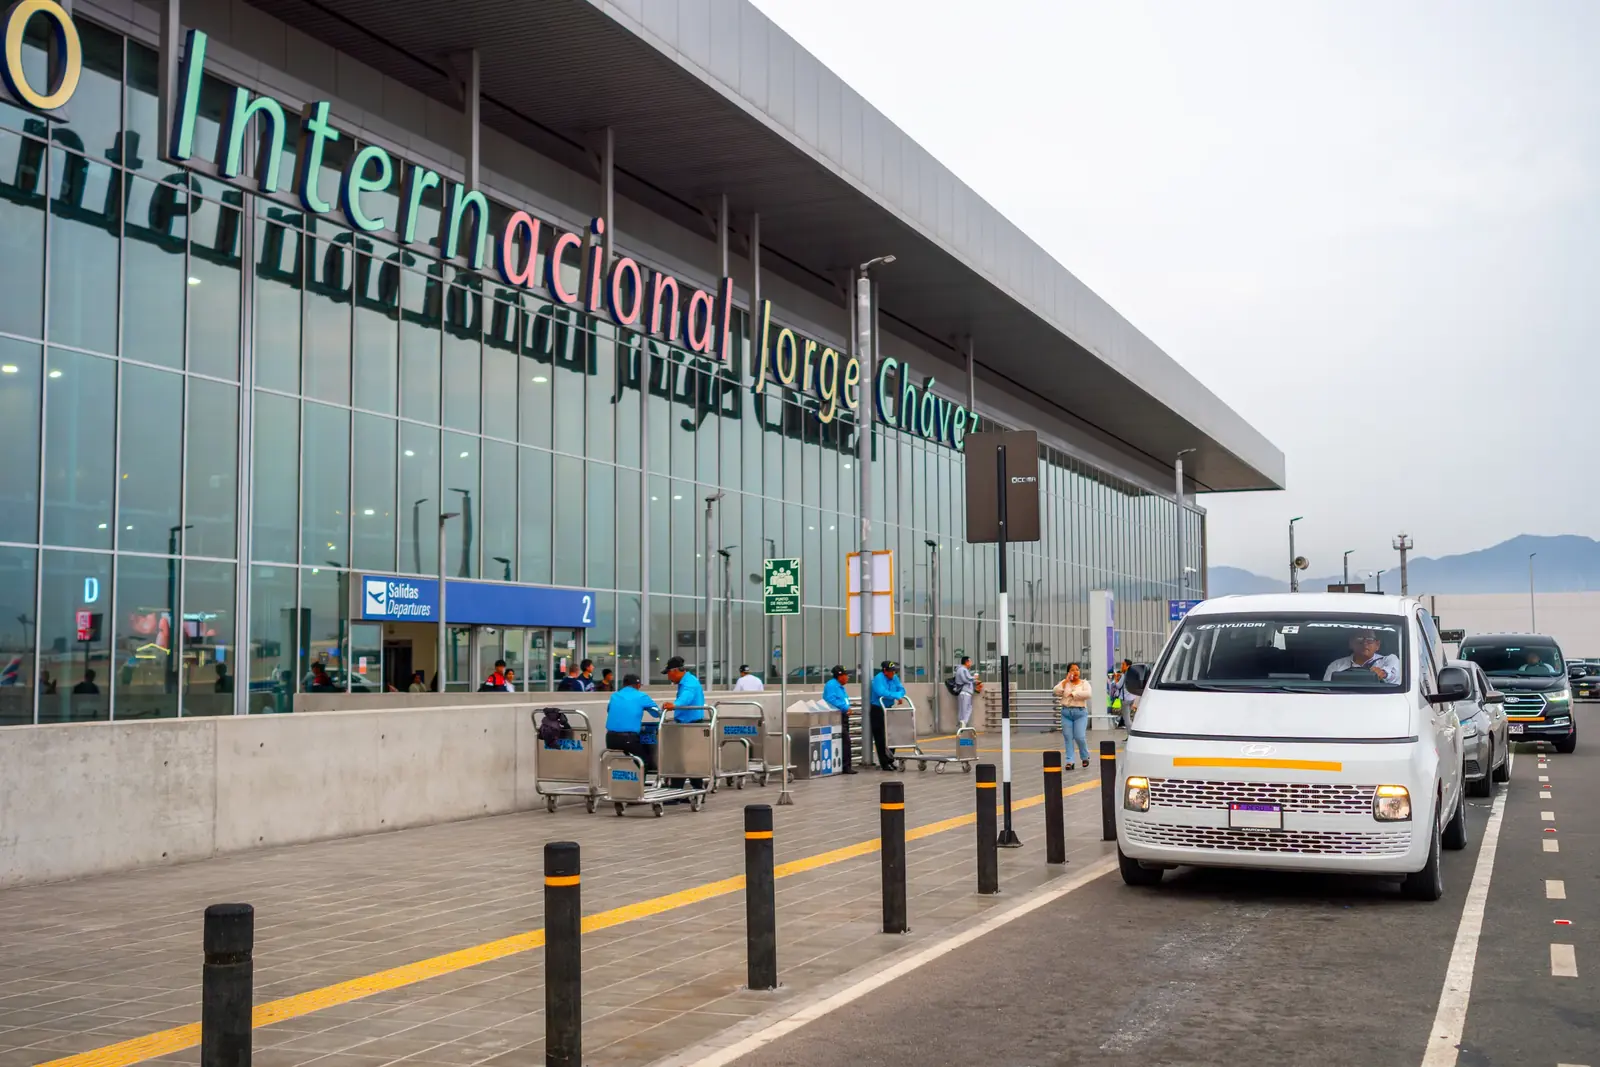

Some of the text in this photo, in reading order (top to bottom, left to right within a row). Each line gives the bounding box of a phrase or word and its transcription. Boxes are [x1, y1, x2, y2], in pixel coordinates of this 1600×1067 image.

[169, 29, 733, 360] Internacional
[751, 300, 861, 424] Jorge
[84, 577, 99, 603] D
[388, 582, 419, 599] Salidas
[387, 600, 431, 618] Departures
[582, 595, 592, 624] 2
[1307, 622, 1396, 632] AUTONIZA
